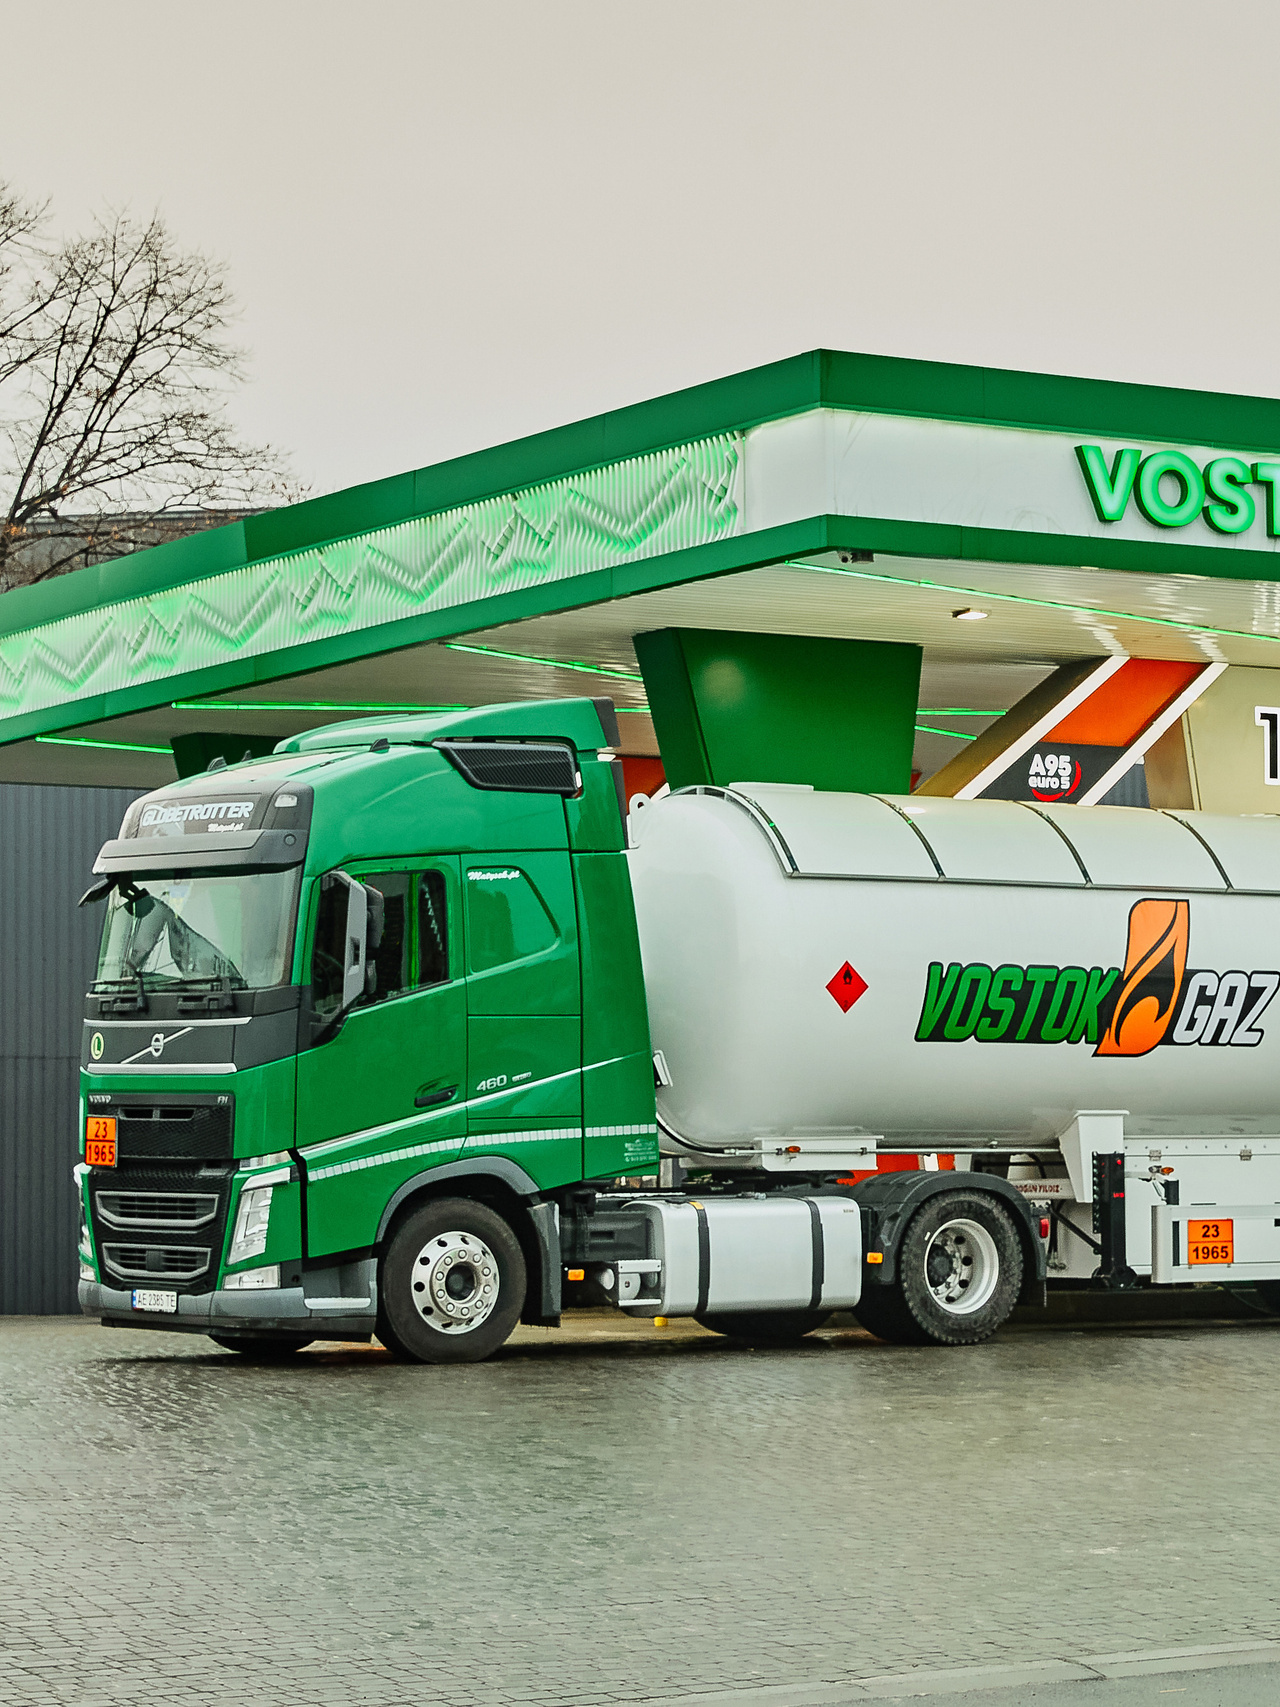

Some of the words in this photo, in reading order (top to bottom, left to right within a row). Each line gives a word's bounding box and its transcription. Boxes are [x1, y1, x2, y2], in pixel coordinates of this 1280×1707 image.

[1257, 709, 1280, 783] 1
[1028, 753, 1072, 777] A95
[142, 801, 254, 827] GLOBETROTTER
[916, 963, 1121, 1043] VOSTOK
[1172, 971, 1280, 1045] GAZ
[476, 1074, 507, 1091] 460
[94, 1121, 108, 1139] 23
[88, 1144, 115, 1162] 1965
[1202, 1224, 1220, 1238] 23
[1192, 1246, 1229, 1260] 1965
